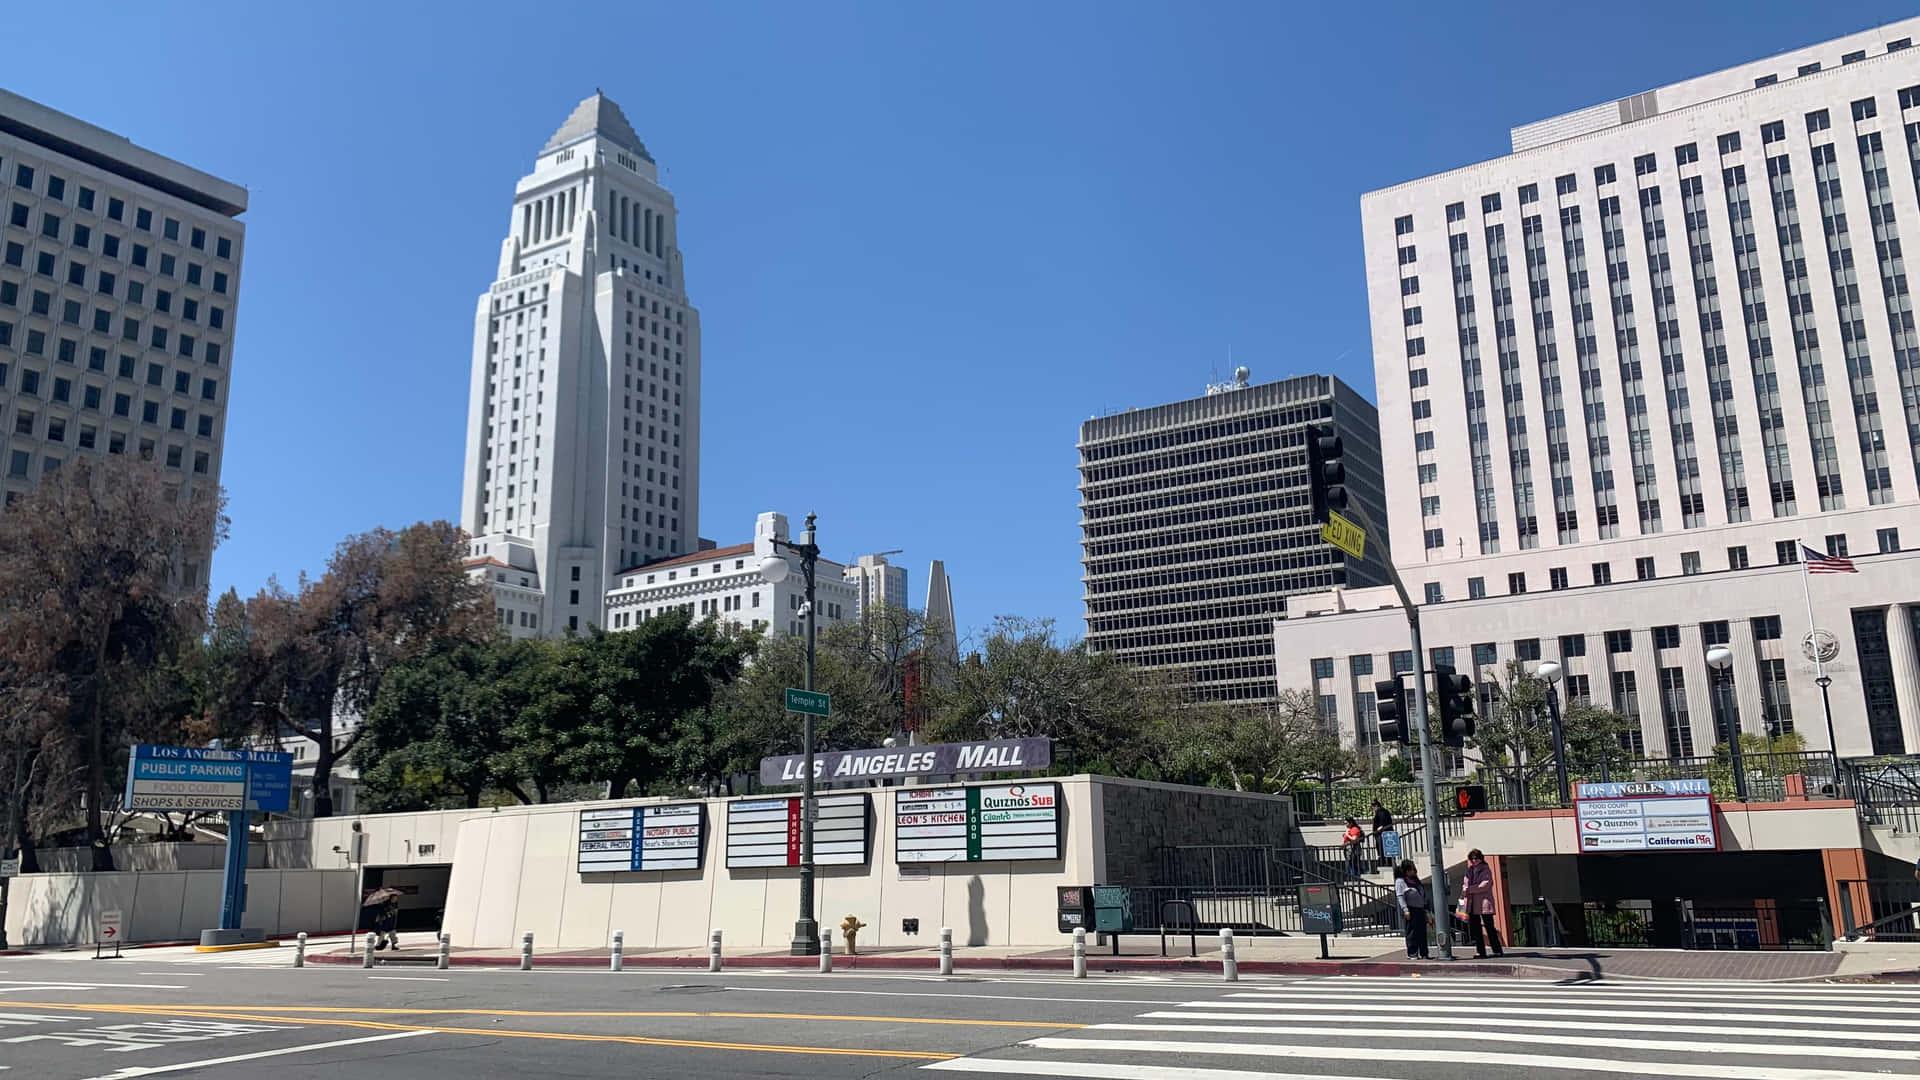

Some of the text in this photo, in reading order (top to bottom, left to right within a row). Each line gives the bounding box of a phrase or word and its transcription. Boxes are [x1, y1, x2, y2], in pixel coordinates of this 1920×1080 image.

[1344, 526, 1361, 552] XING
[790, 694, 826, 708] Temple St
[152, 746, 281, 763] LOS ANGELES MALL
[834, 752, 936, 777] ANGELES
[956, 745, 1023, 768] MALL
[141, 763, 186, 775] PUBLIC
[190, 764, 242, 777] PARKING
[153, 783, 226, 794] FOOD COURT
[1582, 781, 1705, 796] LOS ANGELES MALL
[133, 797, 242, 809] SHOPS & SERVICES
[897, 814, 964, 824] LEON'S KITCHEN
[983, 811, 1011, 821] Cilantro
[646, 827, 696, 836] NOTARY PUBLIC
[581, 841, 631, 850] FEDERAL PHOTO
[1648, 837, 1695, 846] California
[418, 844, 436, 855] EXIT
